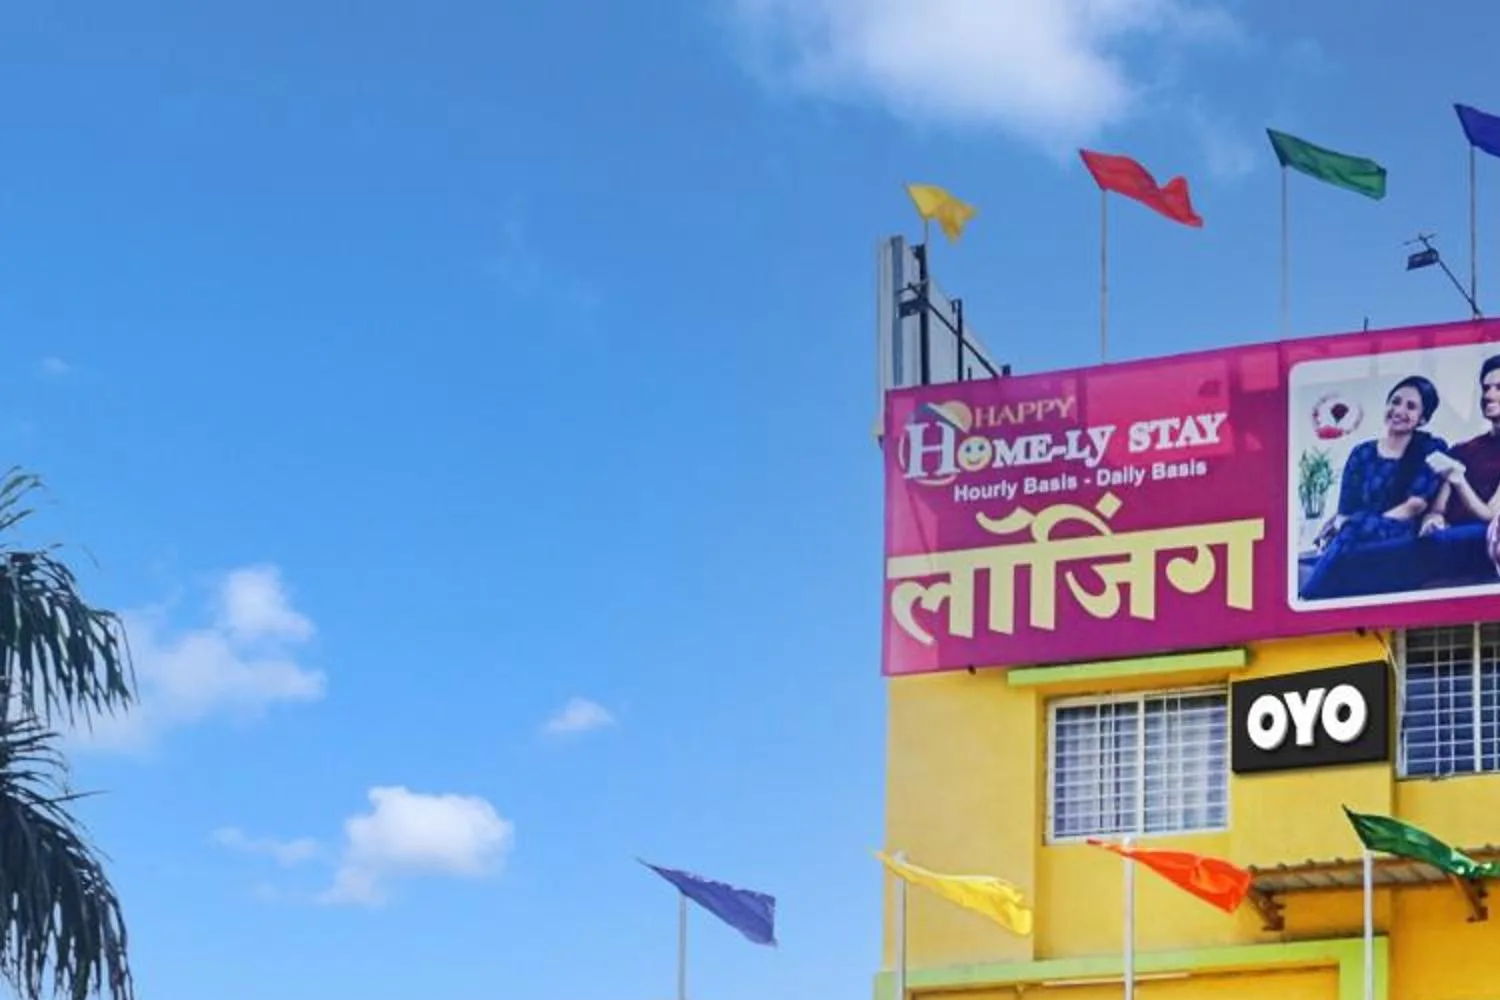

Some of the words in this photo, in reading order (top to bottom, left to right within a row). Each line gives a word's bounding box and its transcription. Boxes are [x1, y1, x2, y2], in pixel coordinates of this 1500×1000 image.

[973, 396, 1076, 429] HAPPY
[1128, 411, 1228, 455] STAY
[953, 478, 1017, 503] Hourly
[1023, 476, 1078, 496] Basis
[1096, 466, 1145, 489] Daily
[1152, 458, 1208, 482] Basis
[886, 490, 1266, 646] लॉजिंग
[1247, 683, 1369, 750] OYO
